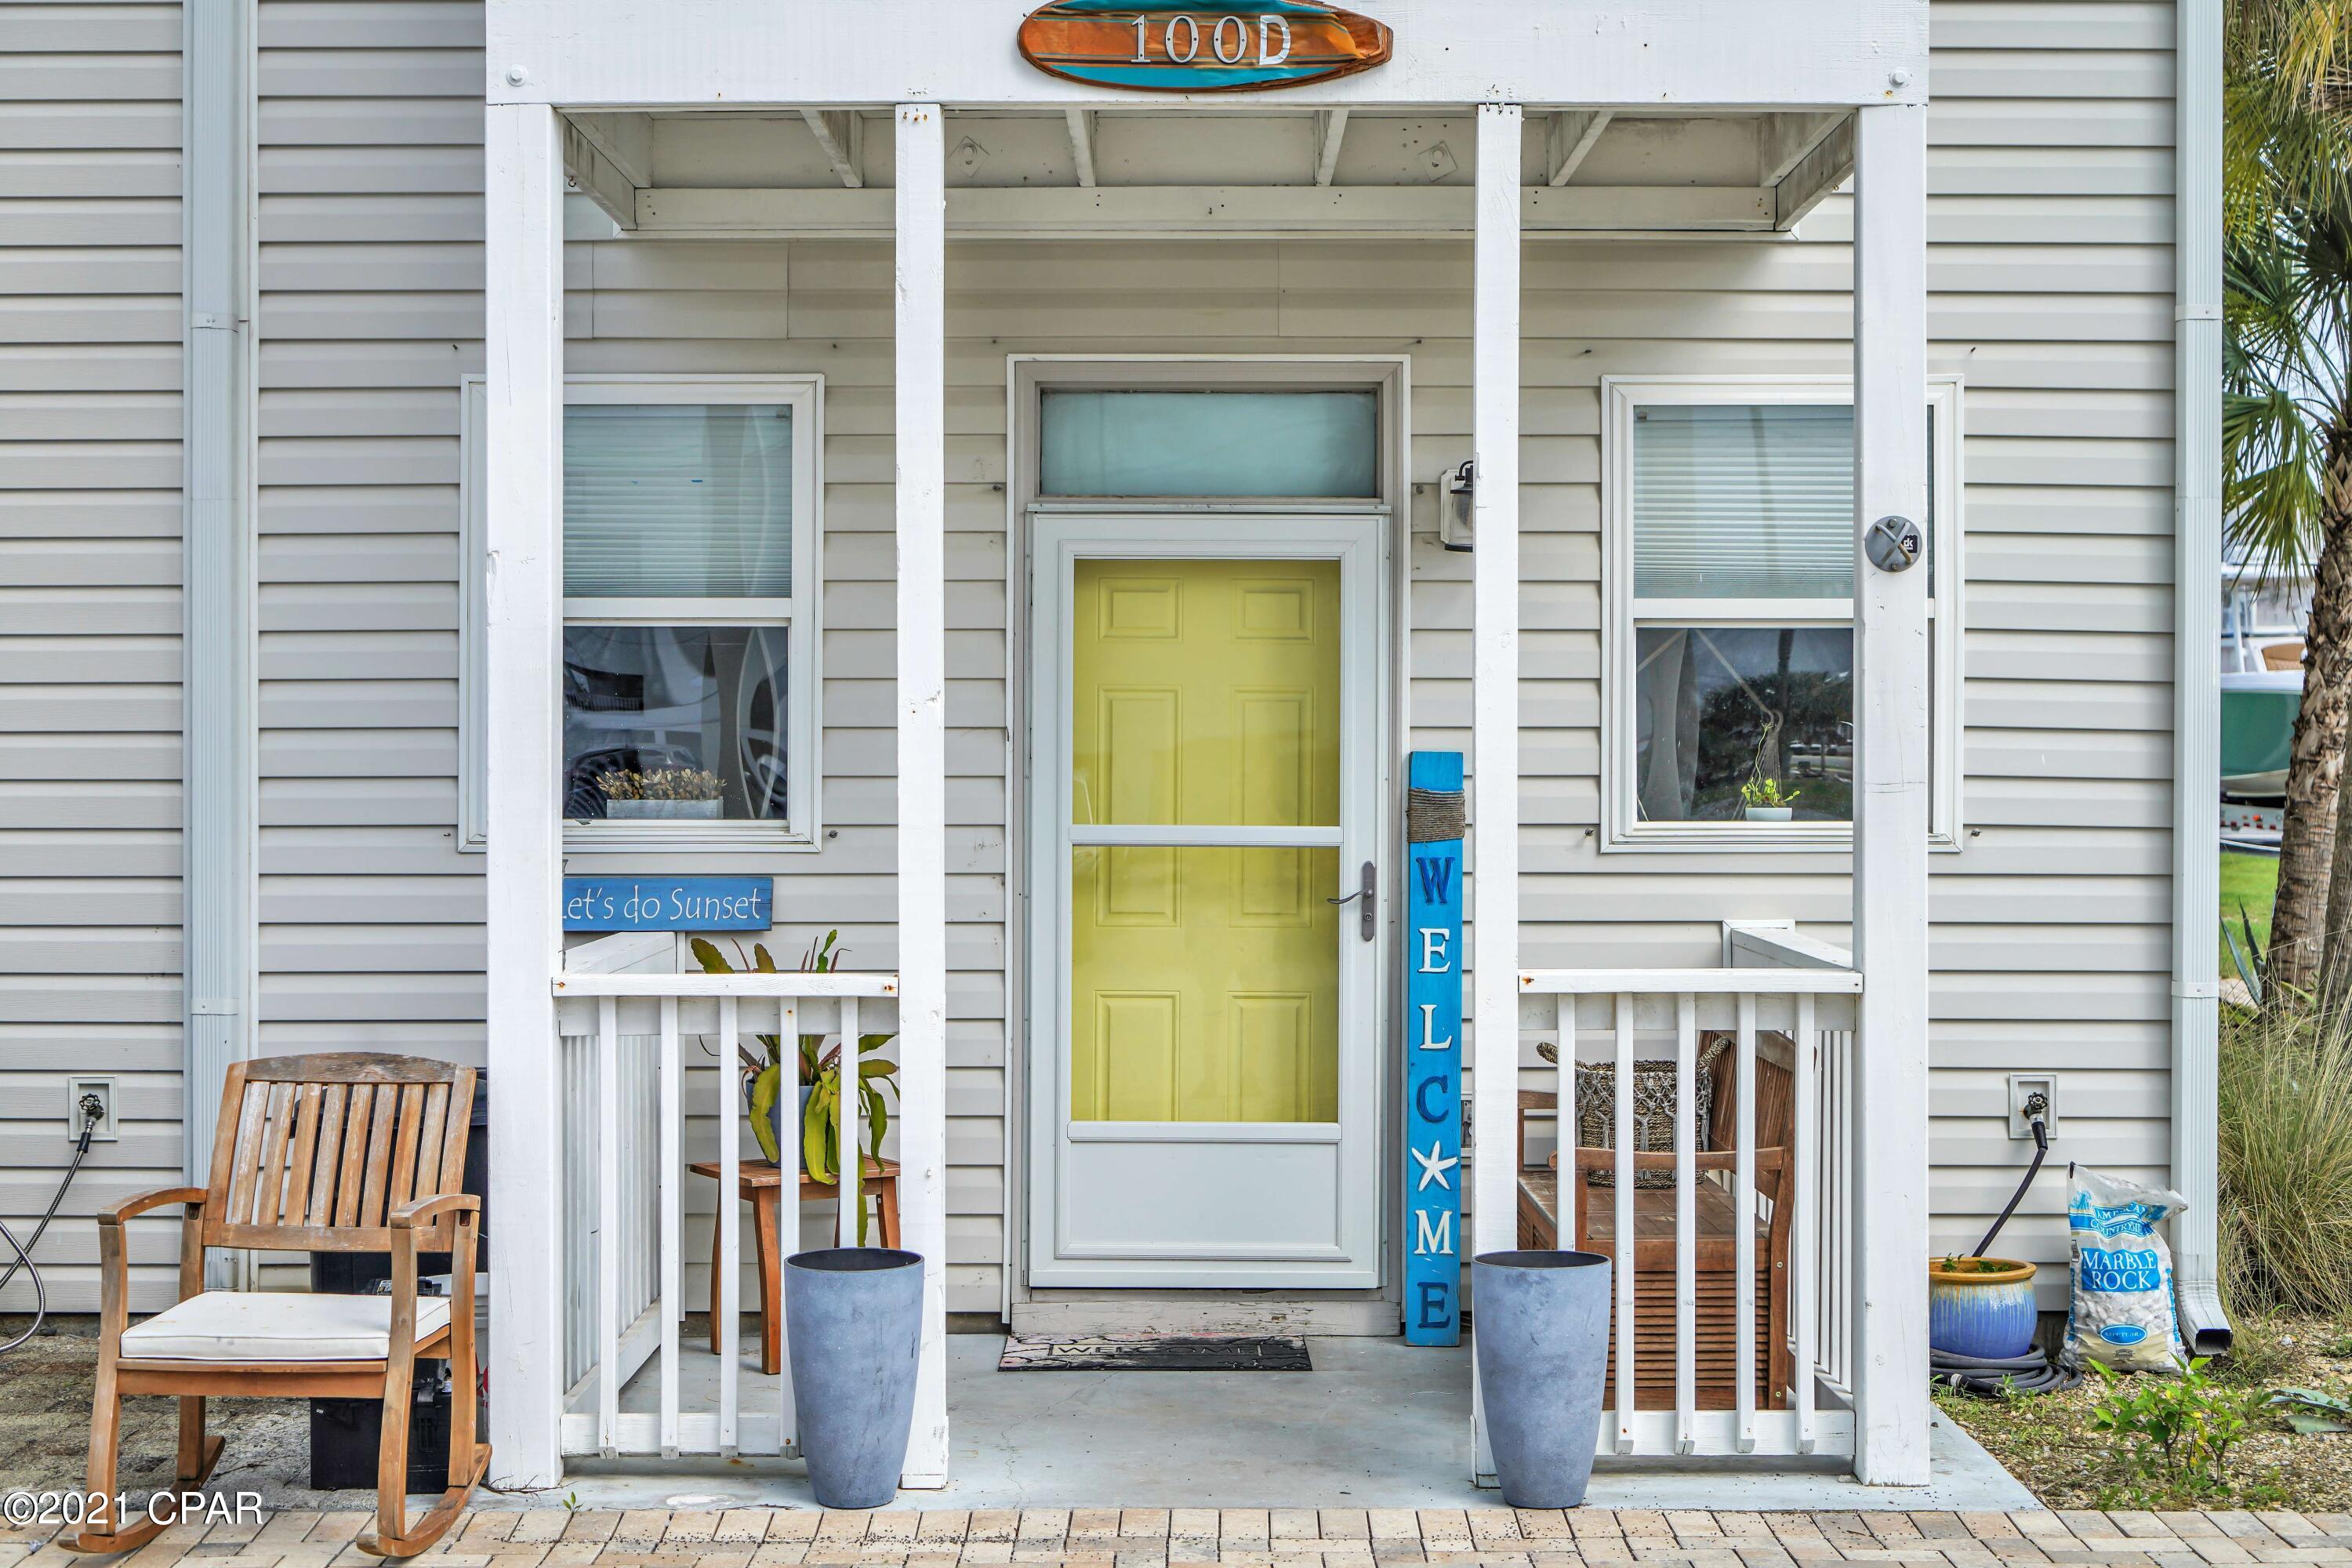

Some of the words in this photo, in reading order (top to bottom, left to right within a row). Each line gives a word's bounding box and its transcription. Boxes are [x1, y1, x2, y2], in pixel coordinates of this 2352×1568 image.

[1130, 14, 1291, 65] 100D
[562, 887, 614, 920] et's
[624, 884, 660, 924] do
[670, 887, 761, 920] Sunset
[2083, 1251, 2157, 1270] MARBLE
[2092, 1271, 2152, 1290] ROCK
